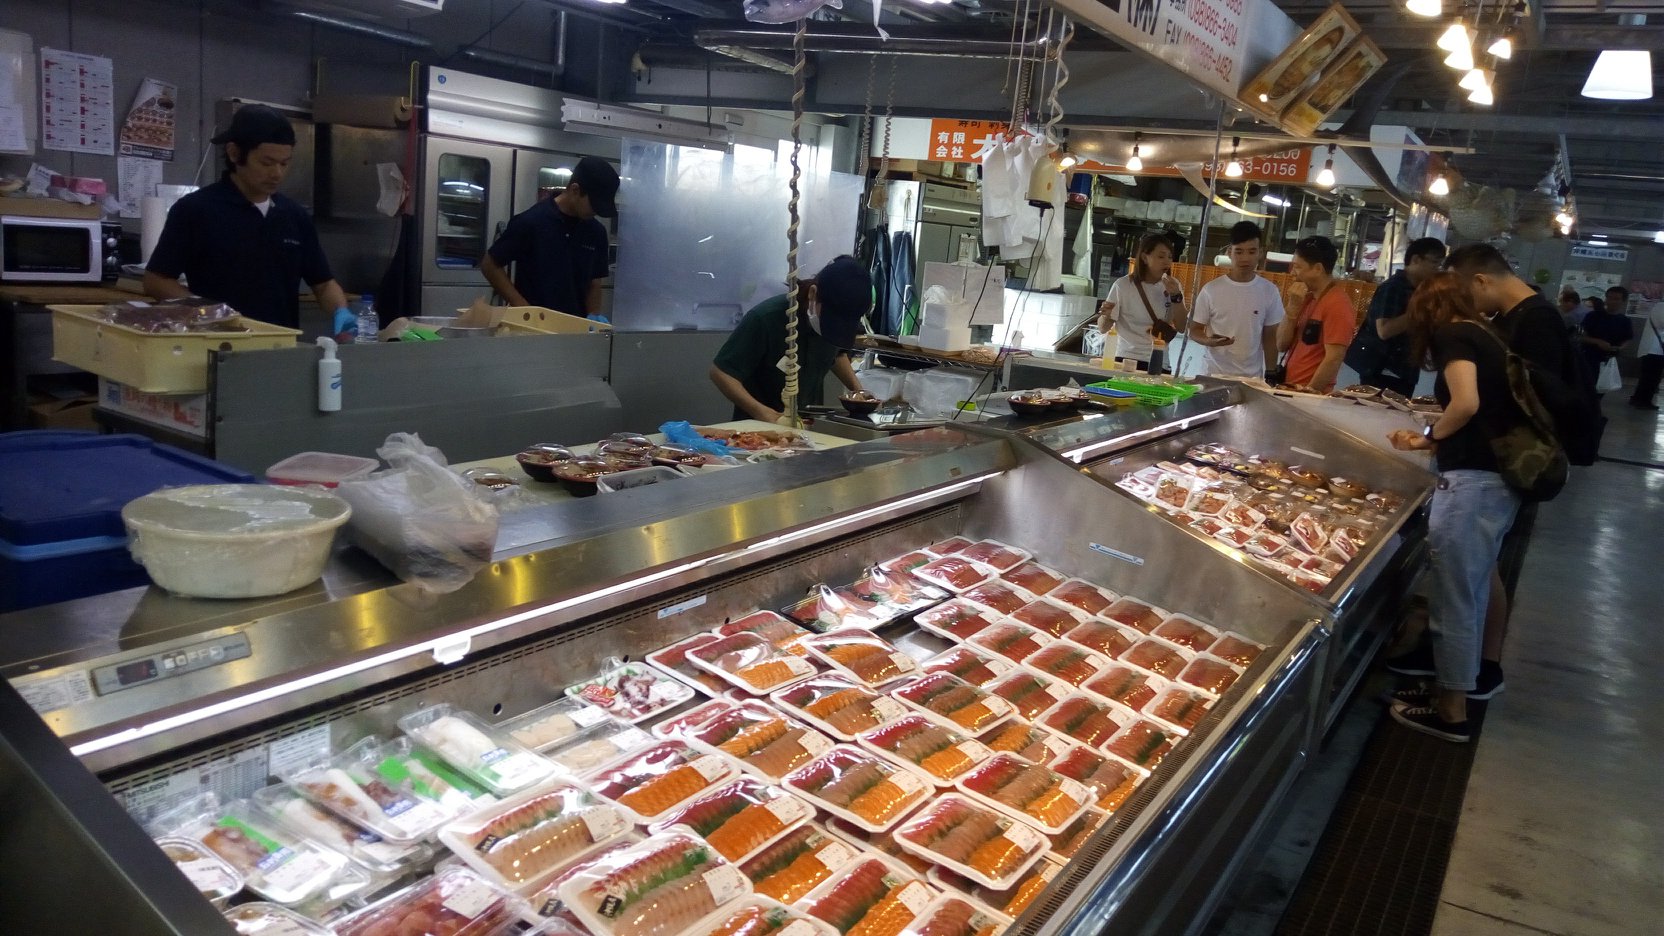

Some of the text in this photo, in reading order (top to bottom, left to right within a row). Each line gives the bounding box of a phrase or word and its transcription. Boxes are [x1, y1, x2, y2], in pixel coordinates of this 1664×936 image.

[1165, 18, 1183, 45] FAX
[937, 131, 966, 144] 有限
[935, 145, 964, 158] 会社
